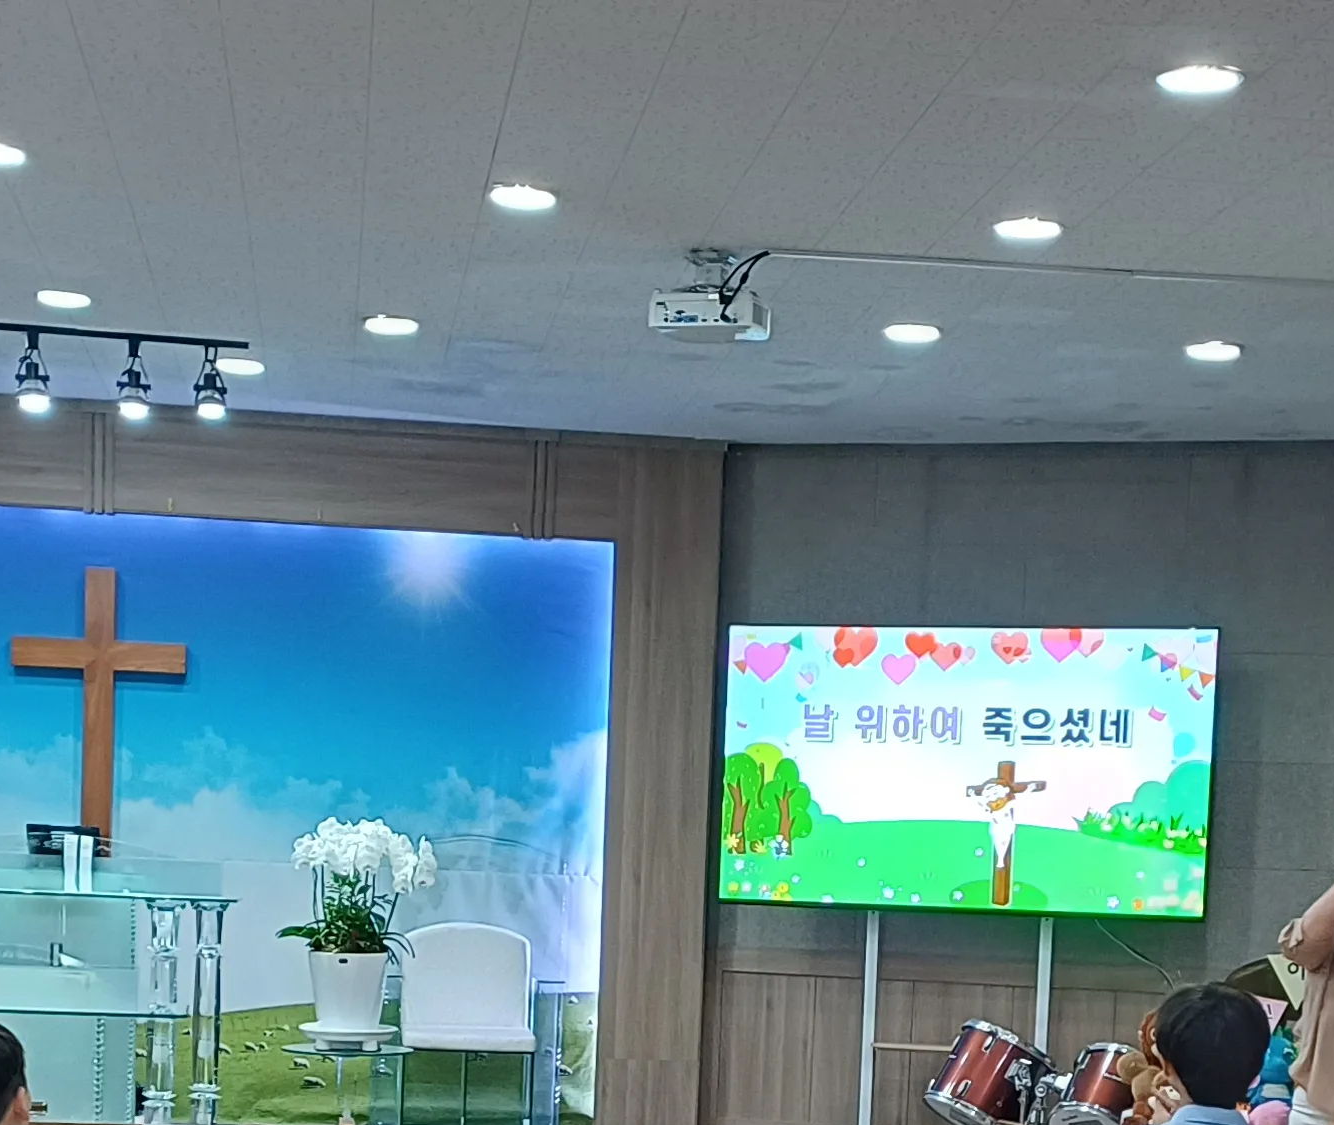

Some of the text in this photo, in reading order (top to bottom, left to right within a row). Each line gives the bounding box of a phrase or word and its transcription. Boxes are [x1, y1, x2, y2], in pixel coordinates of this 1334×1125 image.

[802, 704, 1133, 747] 날 위하여 죽으셨네
